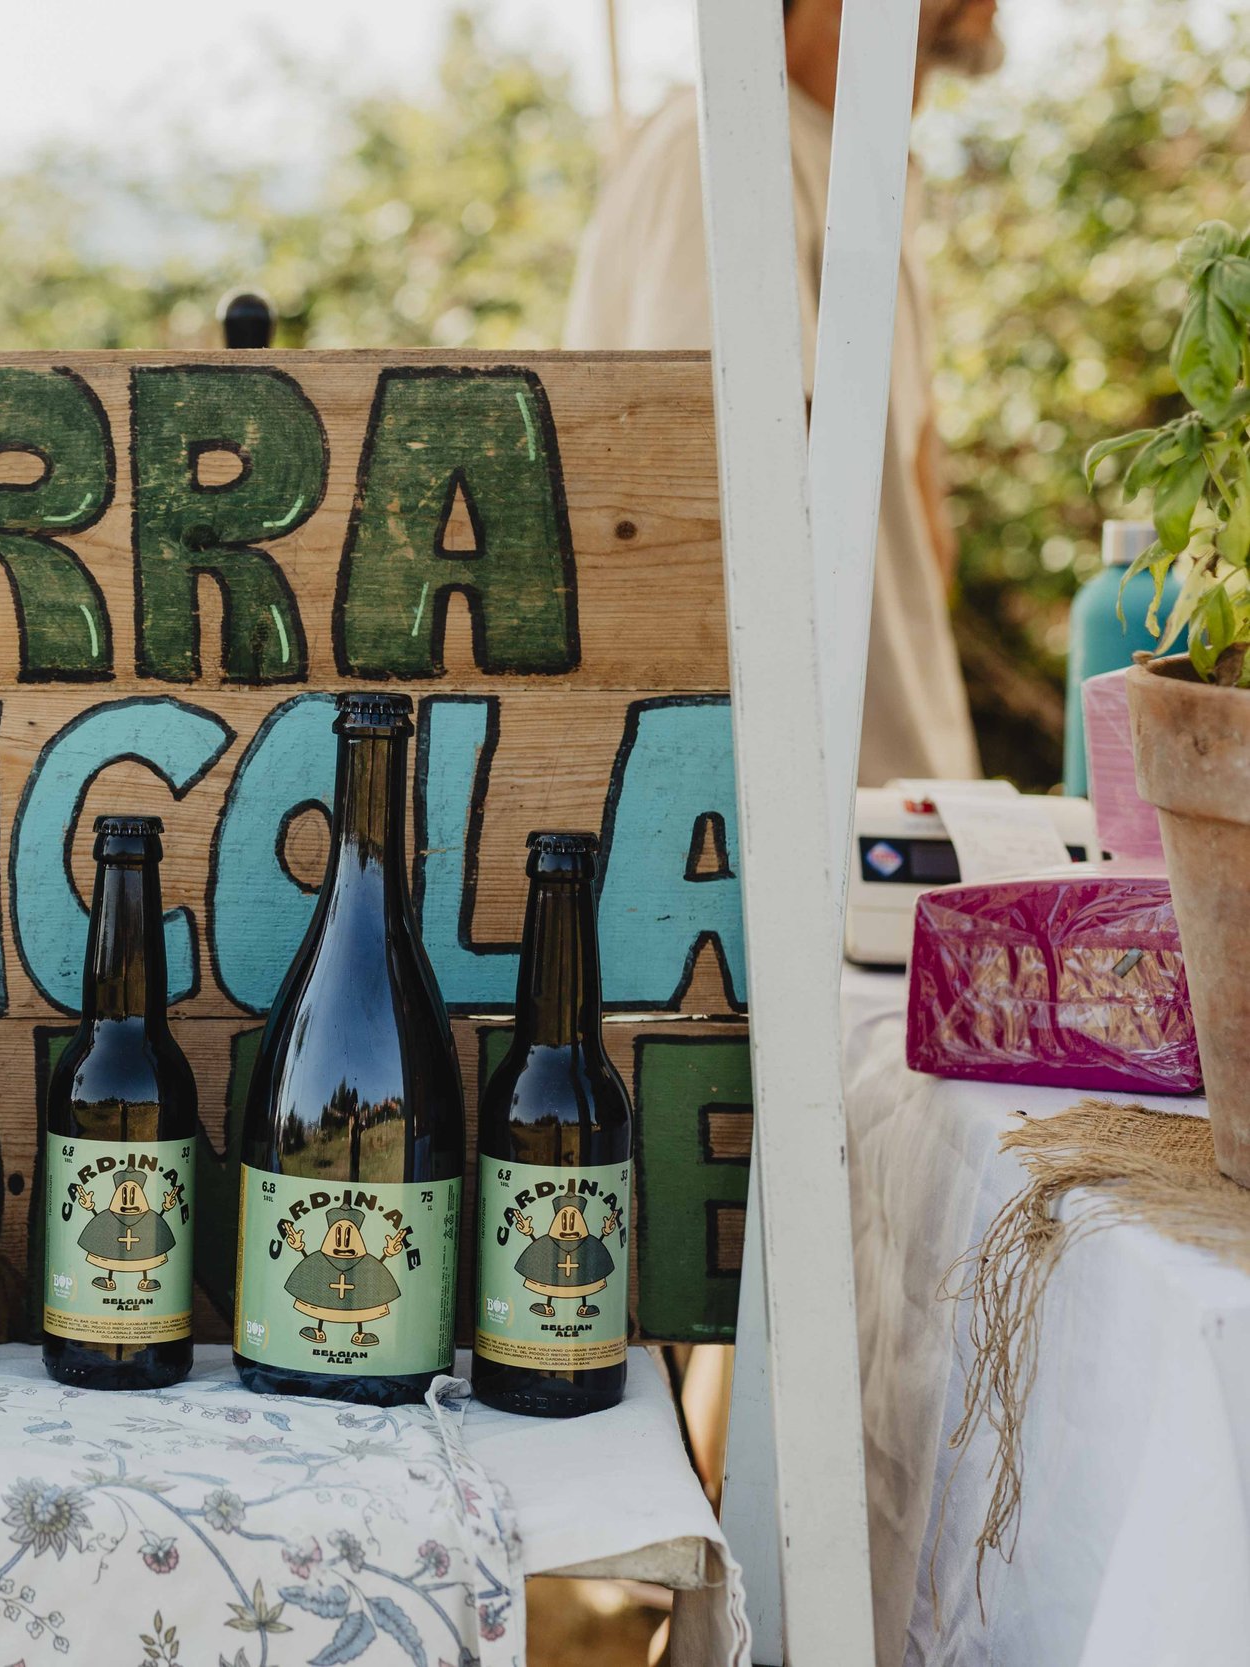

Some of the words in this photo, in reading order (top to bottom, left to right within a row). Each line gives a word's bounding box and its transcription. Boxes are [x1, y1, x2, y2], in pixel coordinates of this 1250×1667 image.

[62, 1145, 75, 1157] 6.8
[182, 1146, 190, 1158] 33
[498, 1168, 512, 1181] 6.8
[621, 1169, 628, 1182] 33
[262, 1181, 276, 1193] 6.8
[421, 1191, 433, 1202] 75
[312, 1349, 368, 1358] BELGIAN
